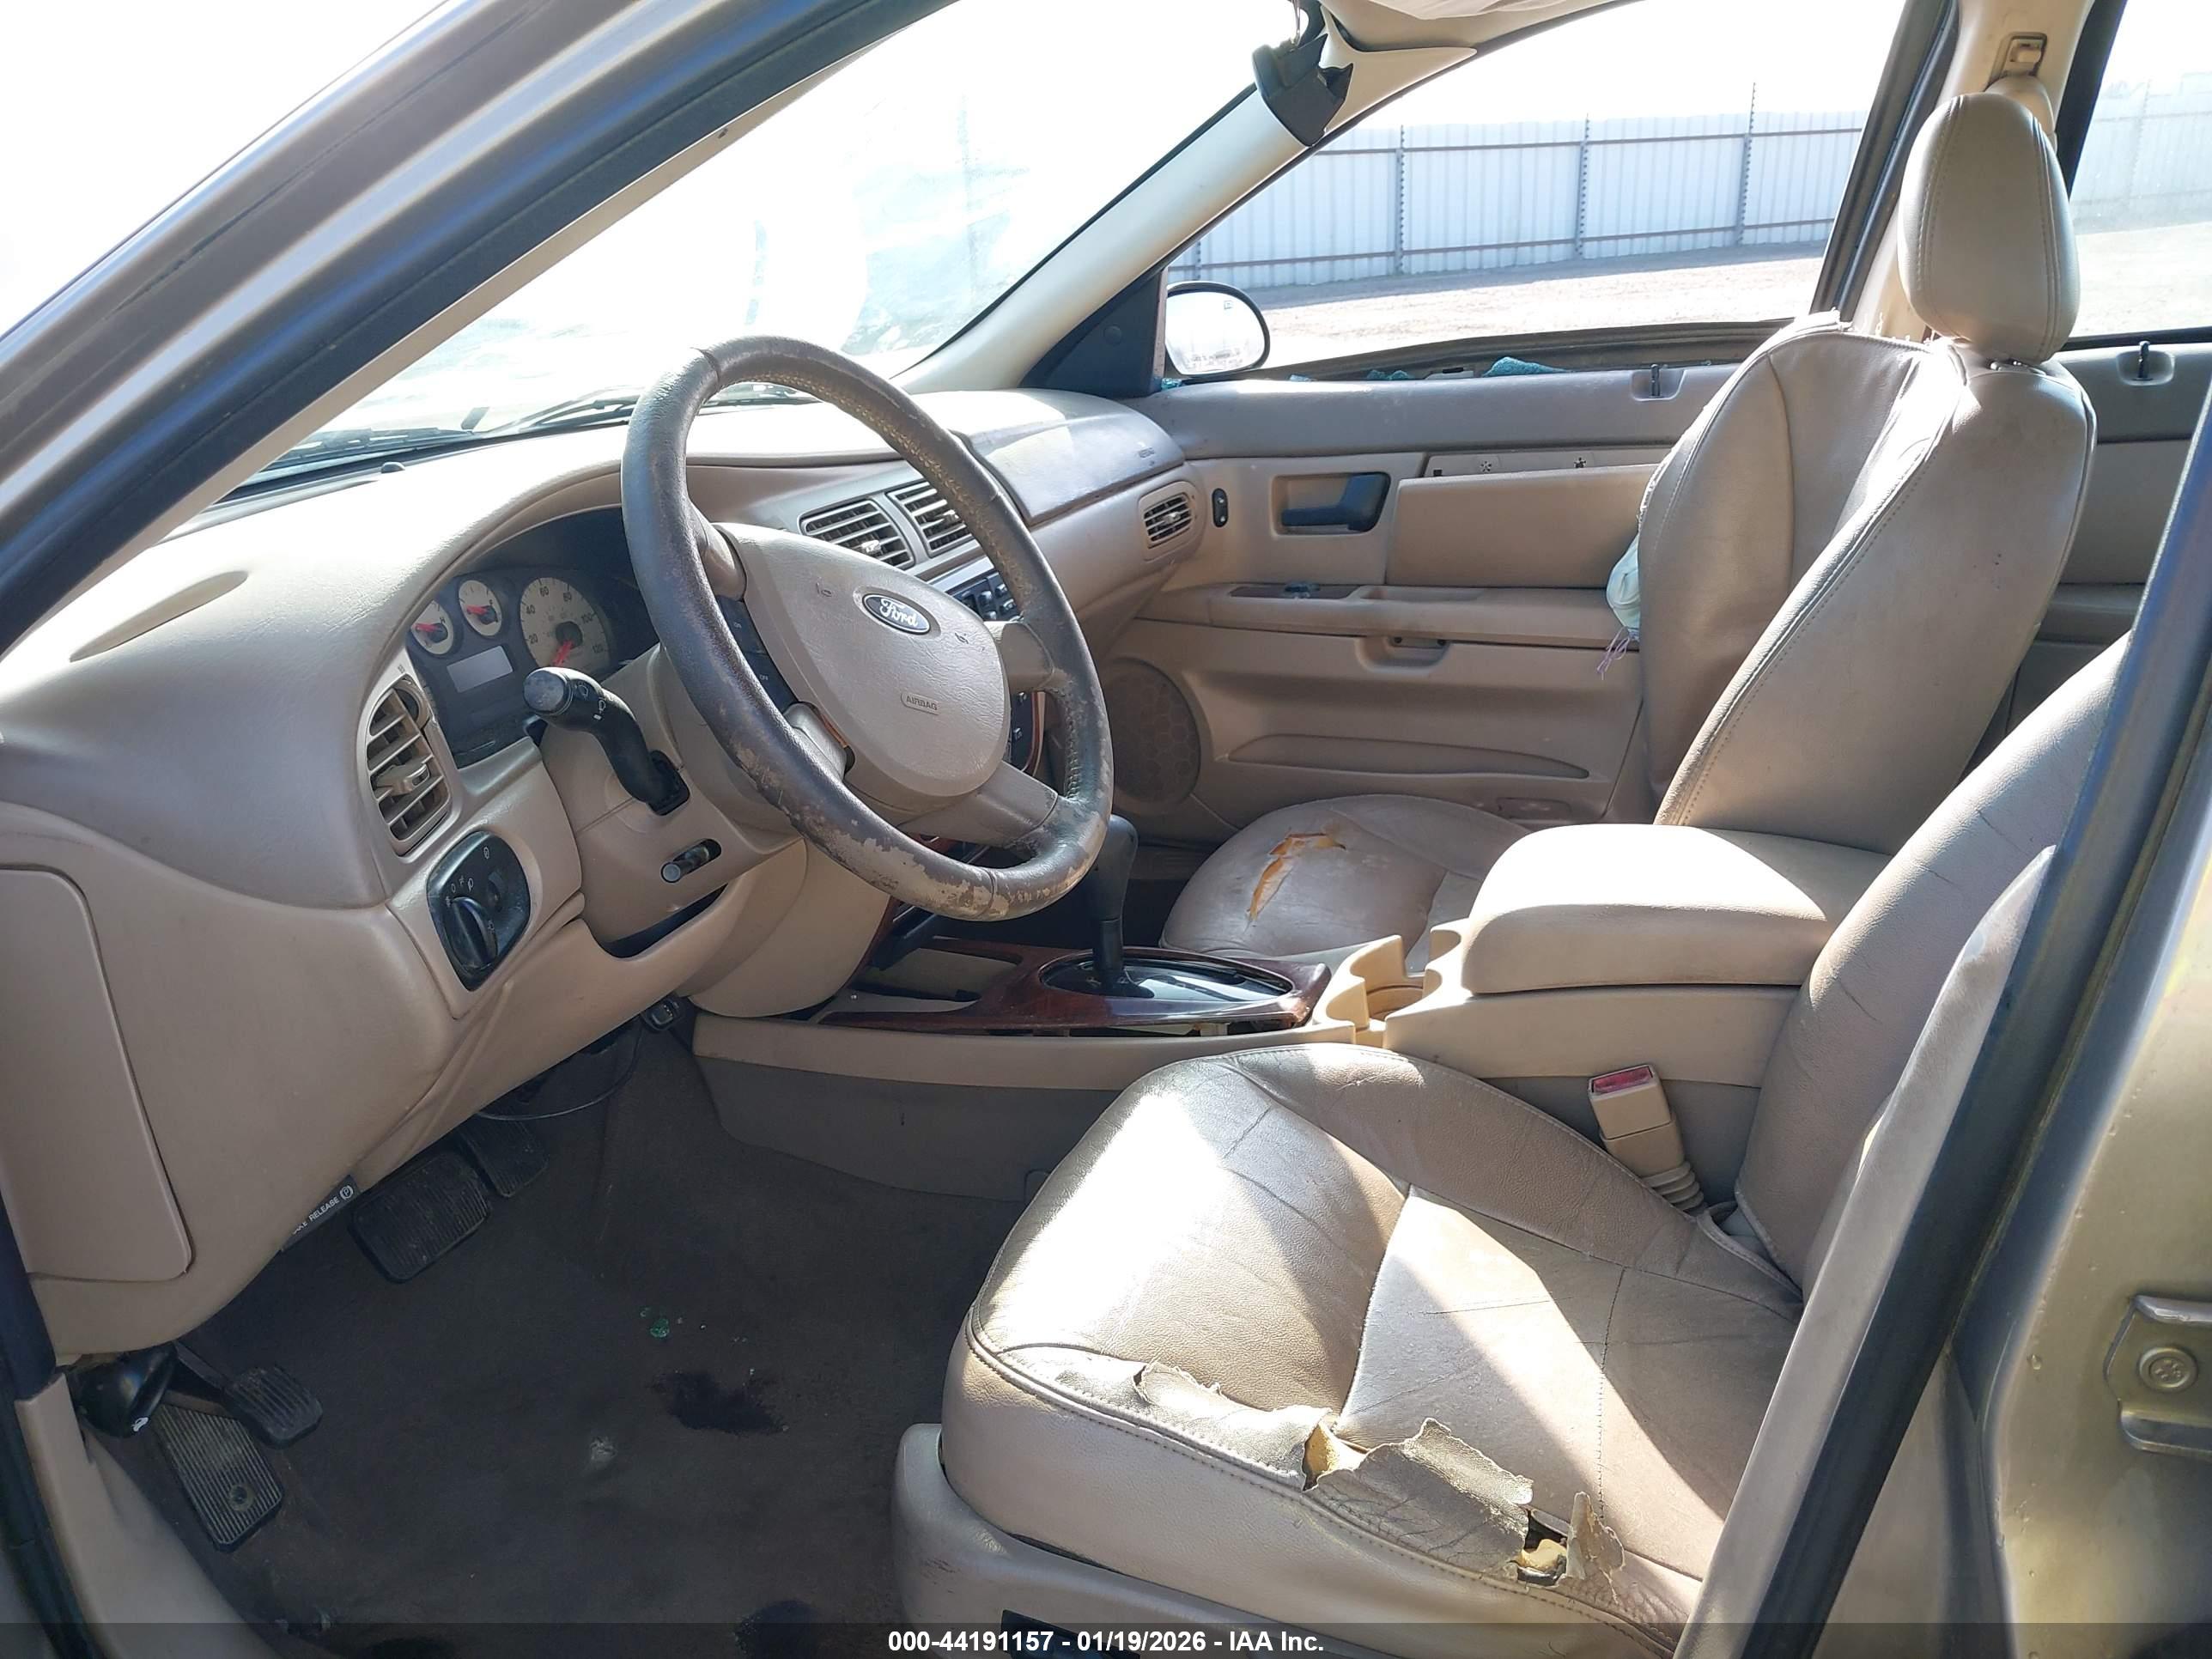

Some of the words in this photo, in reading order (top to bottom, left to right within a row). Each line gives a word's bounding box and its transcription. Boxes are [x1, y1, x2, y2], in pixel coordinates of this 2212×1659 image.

[539, 586, 549, 597] 60
[526, 604, 535, 615] 40
[879, 598, 918, 627] Ford
[528, 633, 538, 645] 20
[906, 695, 938, 711] AIRBAG
[308, 1196, 339, 1222] RELEASE
